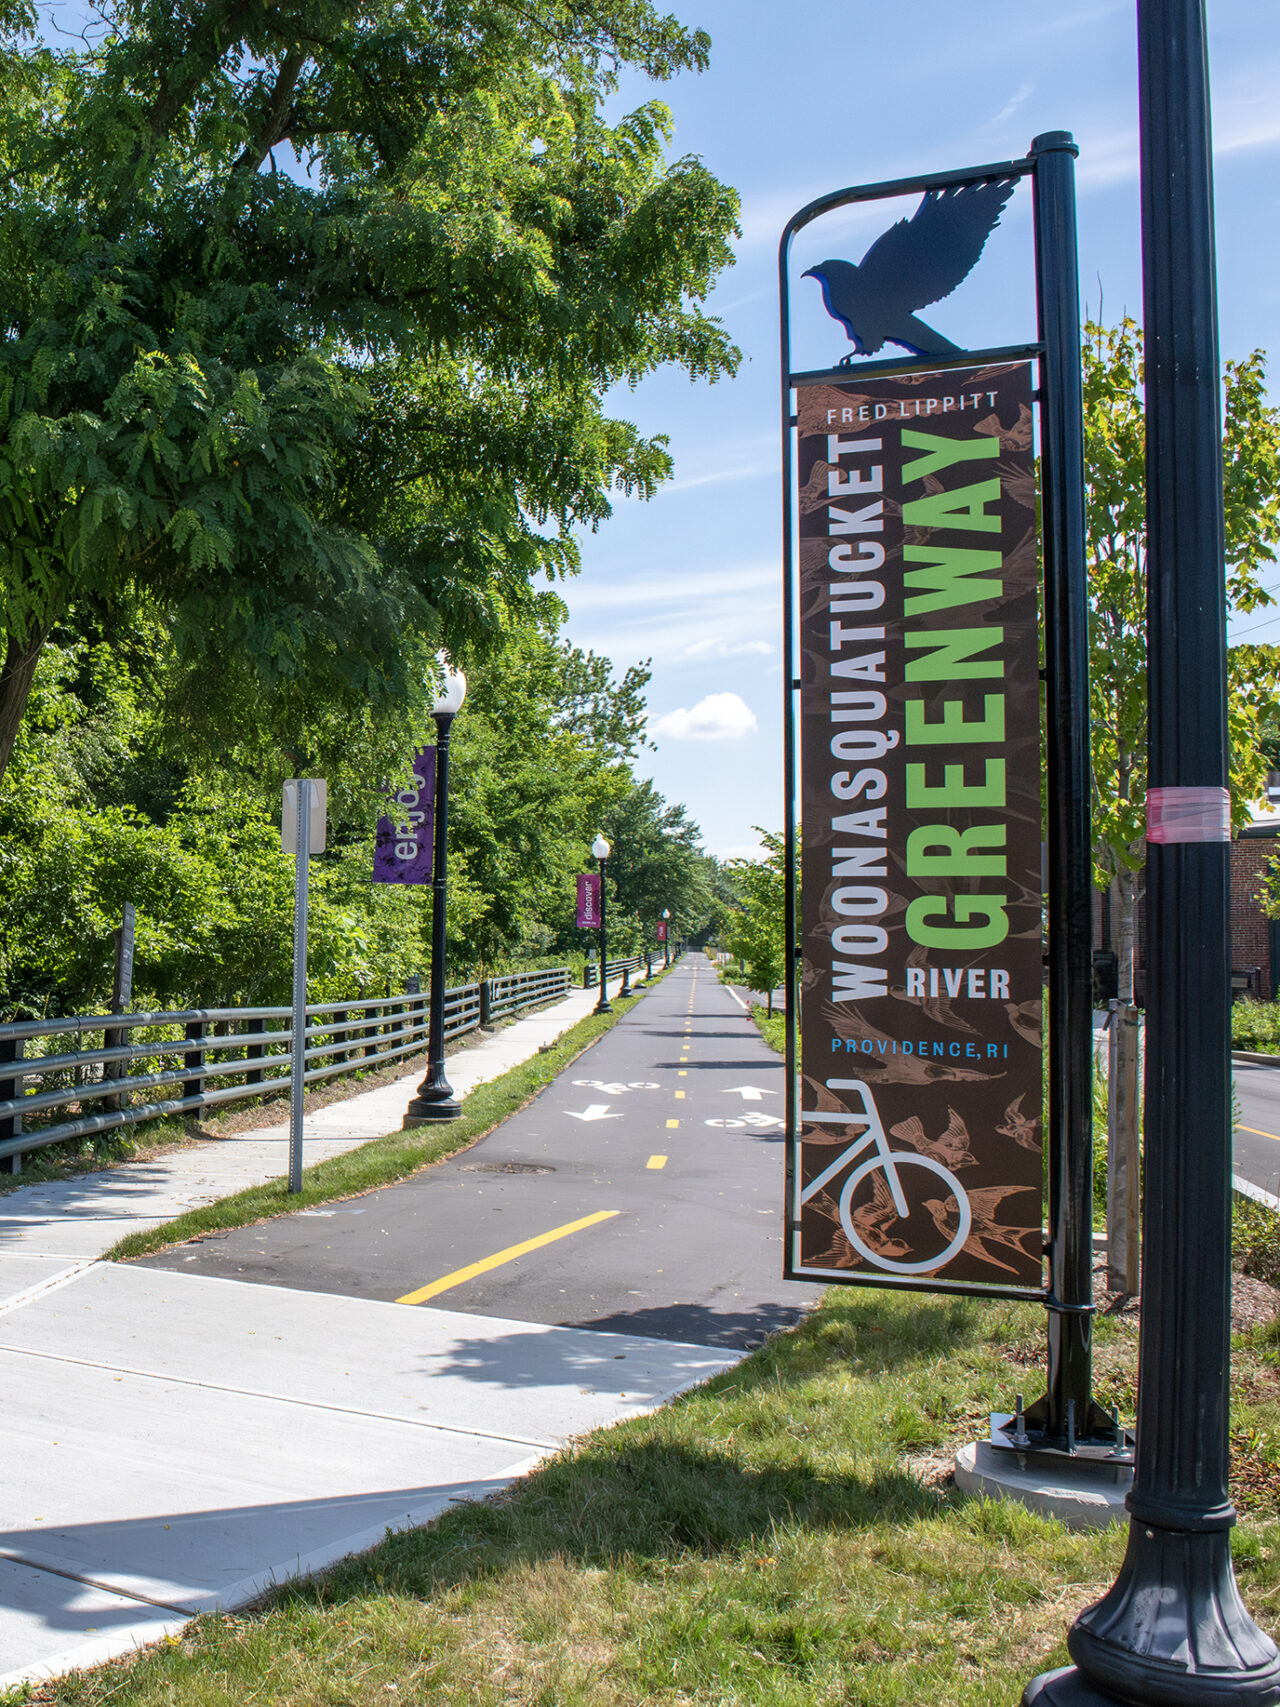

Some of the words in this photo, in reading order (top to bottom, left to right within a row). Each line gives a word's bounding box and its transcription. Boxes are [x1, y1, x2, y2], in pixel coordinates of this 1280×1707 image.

[827, 404, 887, 425] FRED
[900, 391, 999, 417] LIPPITT
[901, 428, 1009, 950] GREENWAY
[828, 433, 900, 1003] WOONASQUATUCKET
[584, 881, 593, 921] discover
[906, 967, 1010, 1000] RIVER
